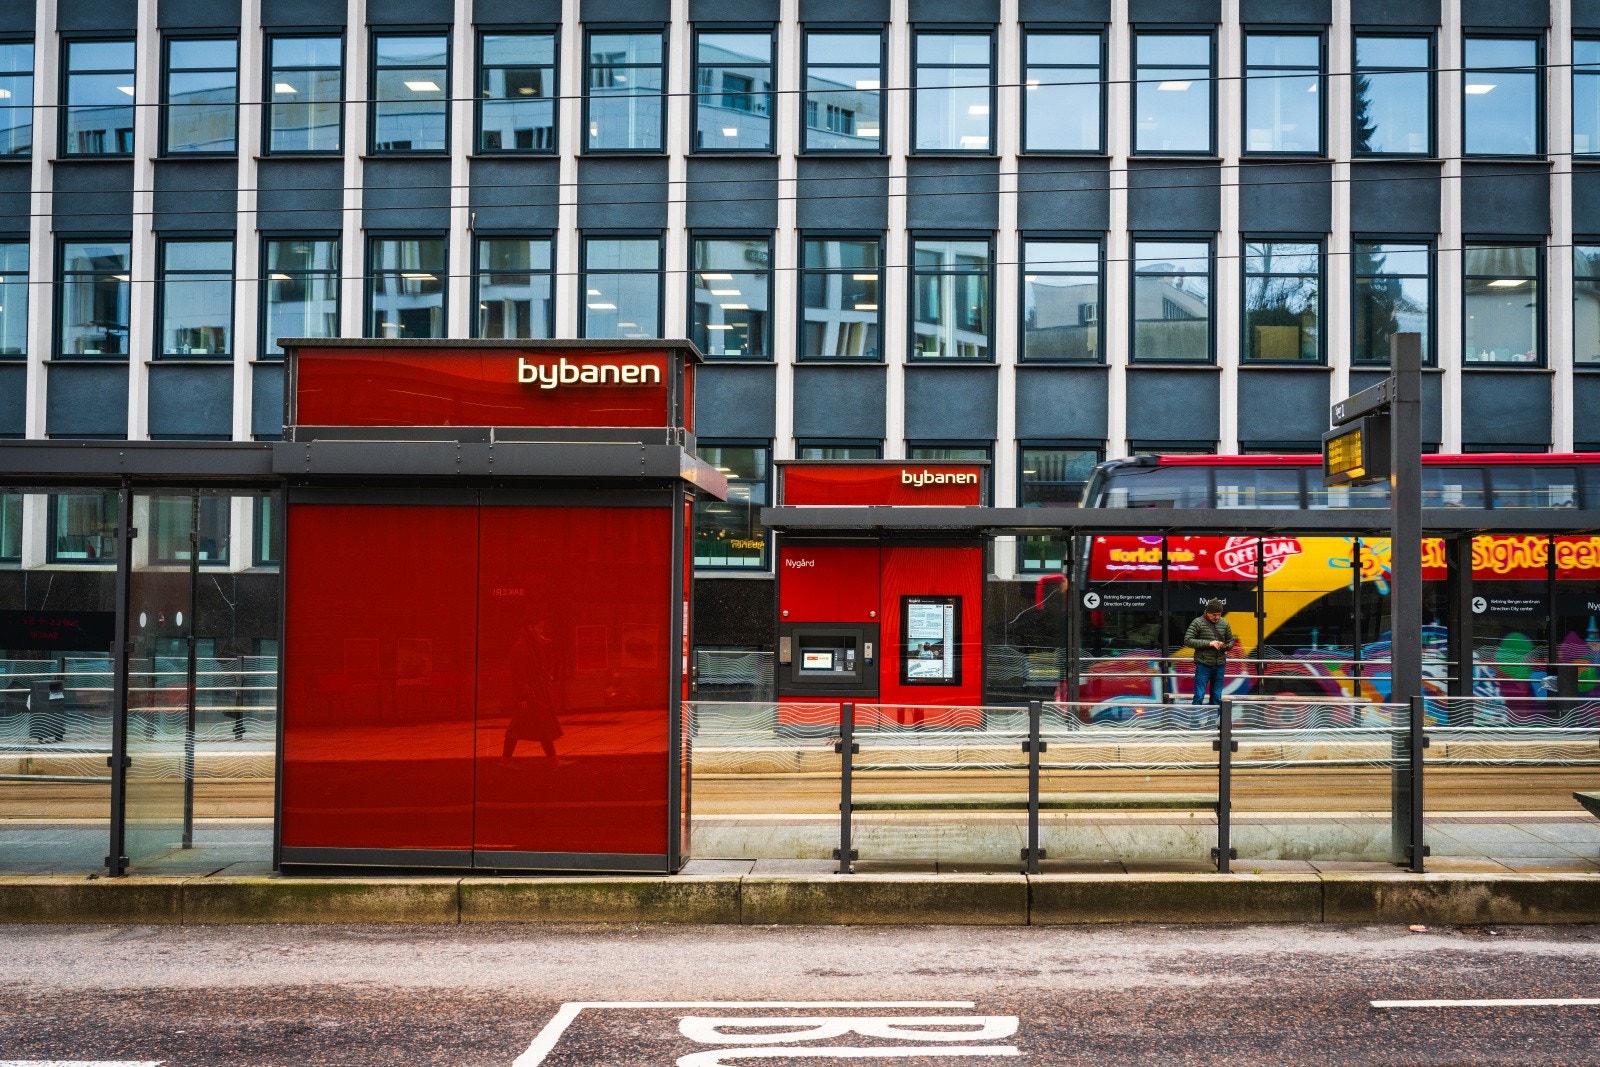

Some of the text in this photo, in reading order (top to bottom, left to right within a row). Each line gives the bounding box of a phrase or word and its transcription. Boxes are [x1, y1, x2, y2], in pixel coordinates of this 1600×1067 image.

[518, 357, 660, 389] bybanen
[901, 469, 977, 487] bybanen
[785, 558, 815, 569] Nygård
